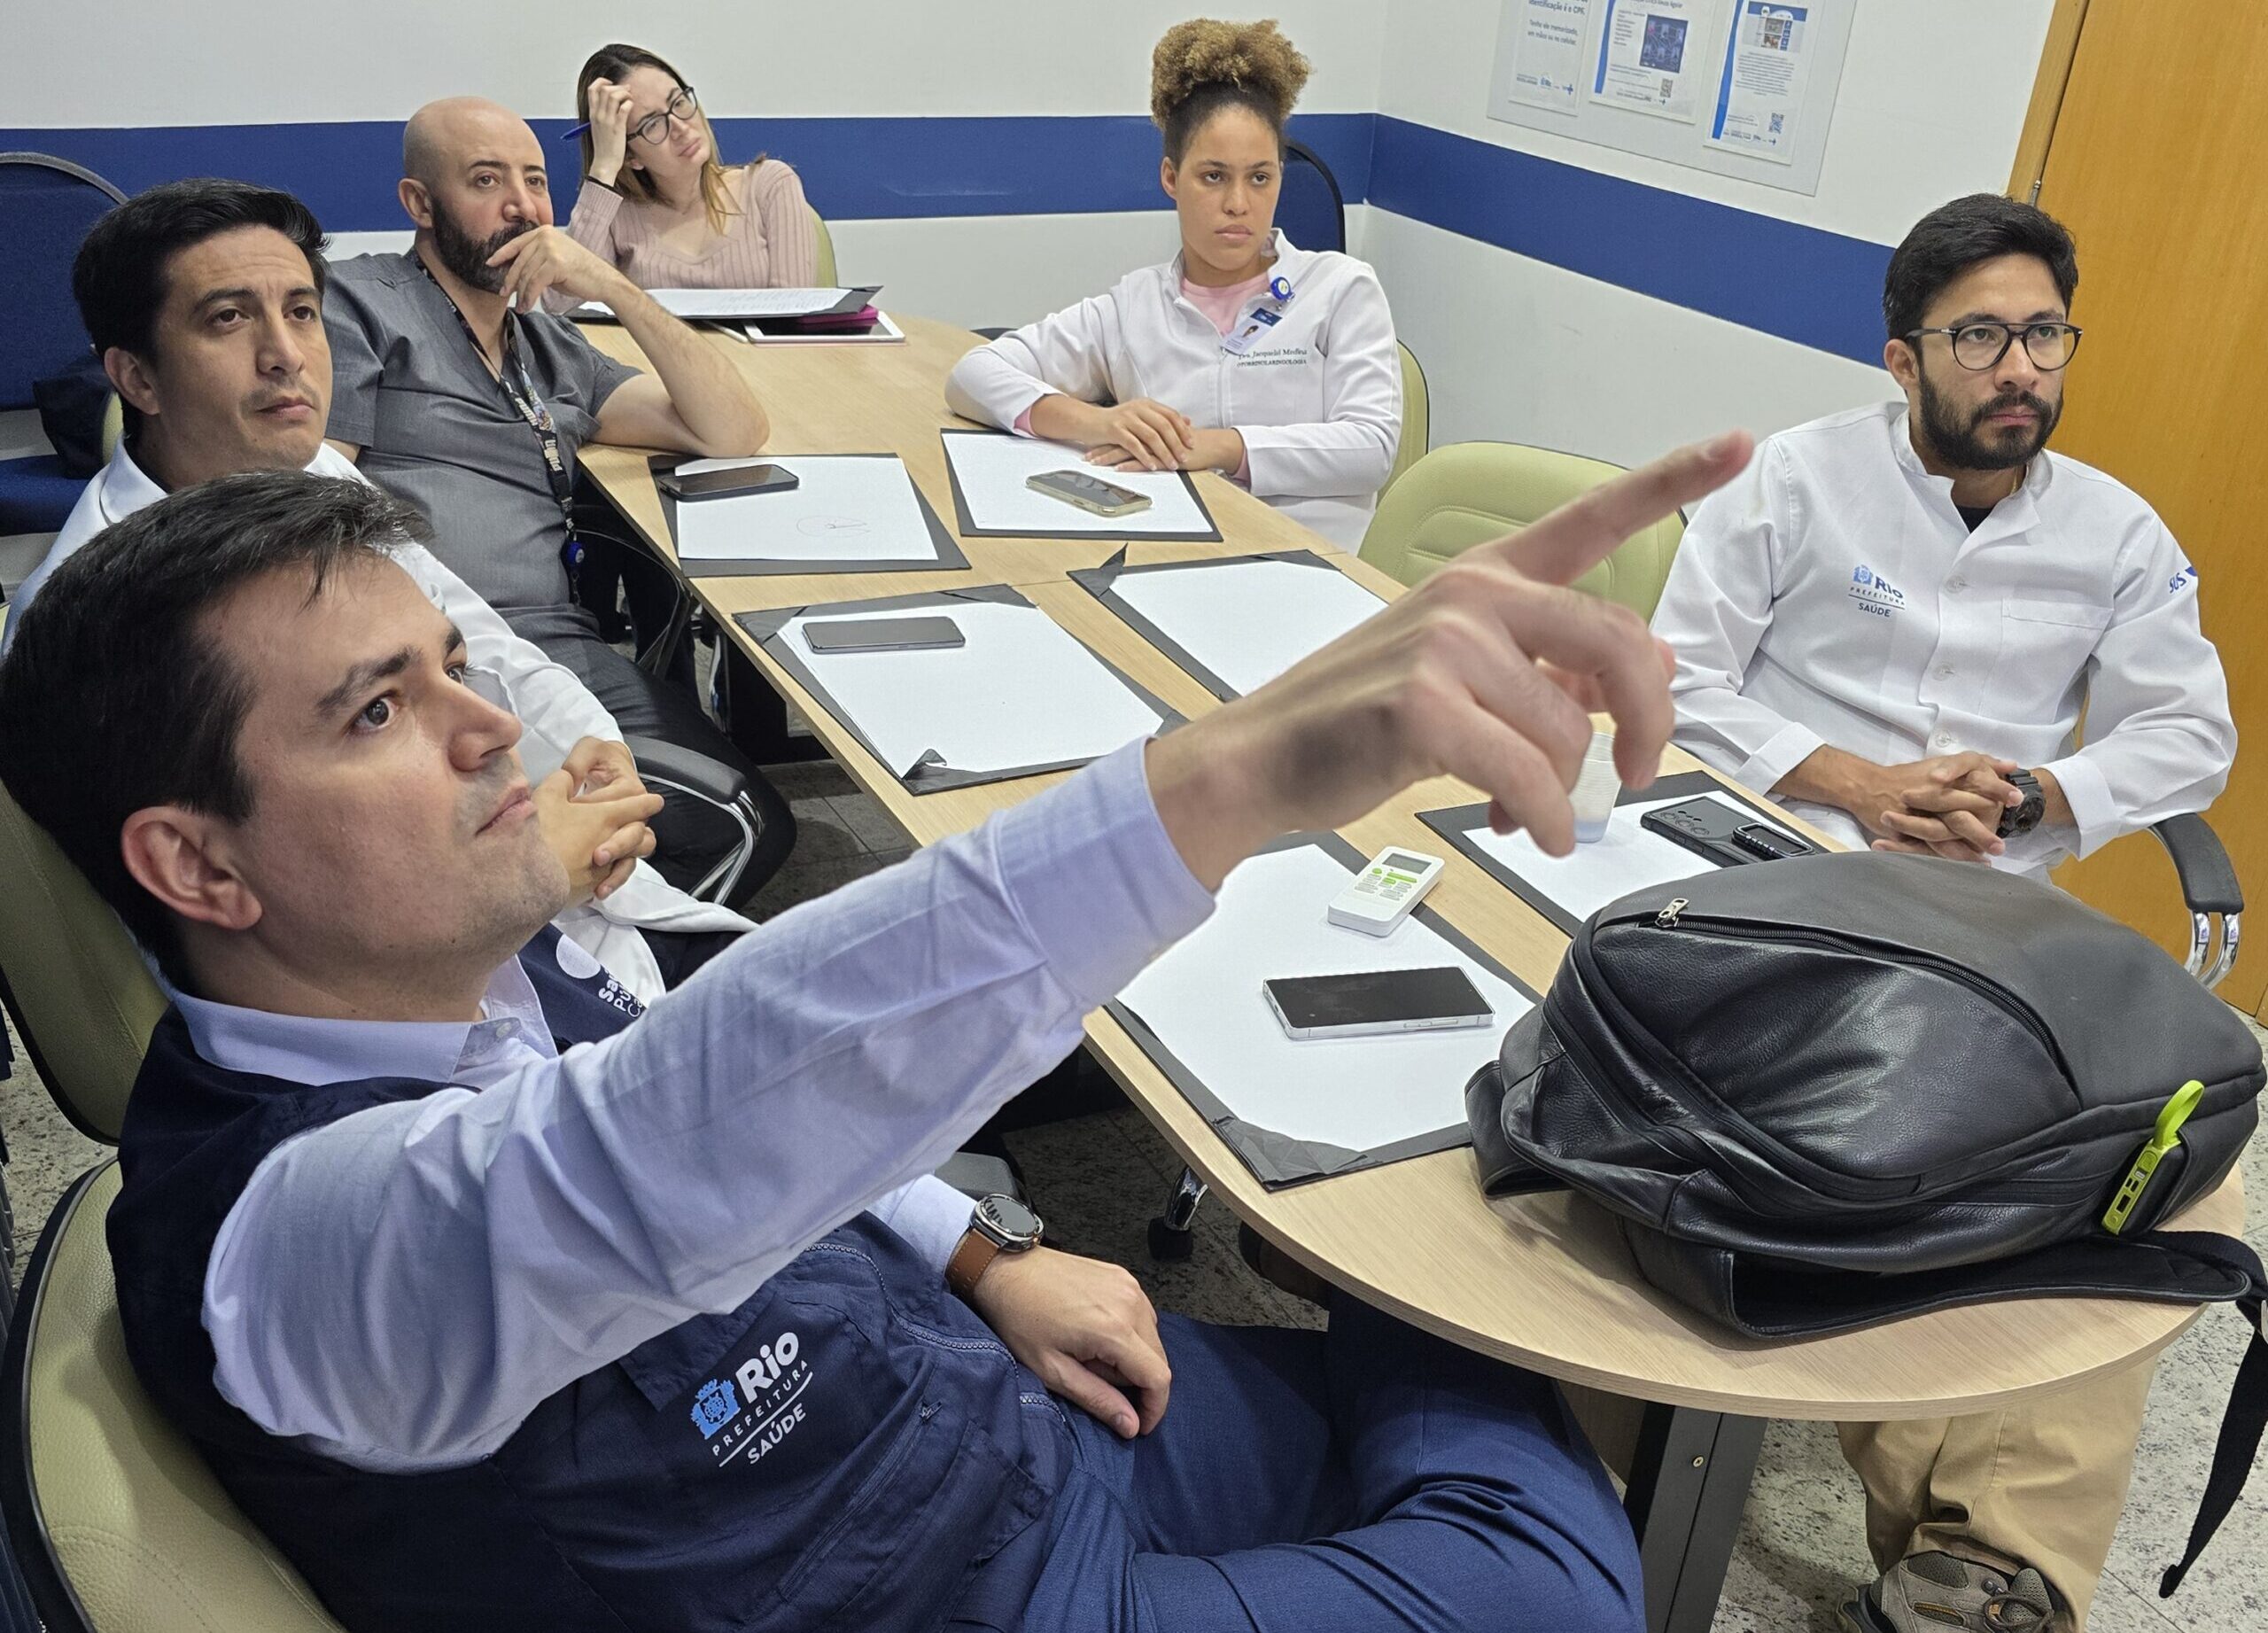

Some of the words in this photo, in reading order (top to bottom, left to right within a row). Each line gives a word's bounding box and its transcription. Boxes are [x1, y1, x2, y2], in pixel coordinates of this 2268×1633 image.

[1850, 587, 1905, 605] PREFEITURA
[1858, 603, 1891, 618] SAÚDE
[712, 1360, 808, 1456] PREFEITURA
[748, 1403, 806, 1465] SAÚDE
